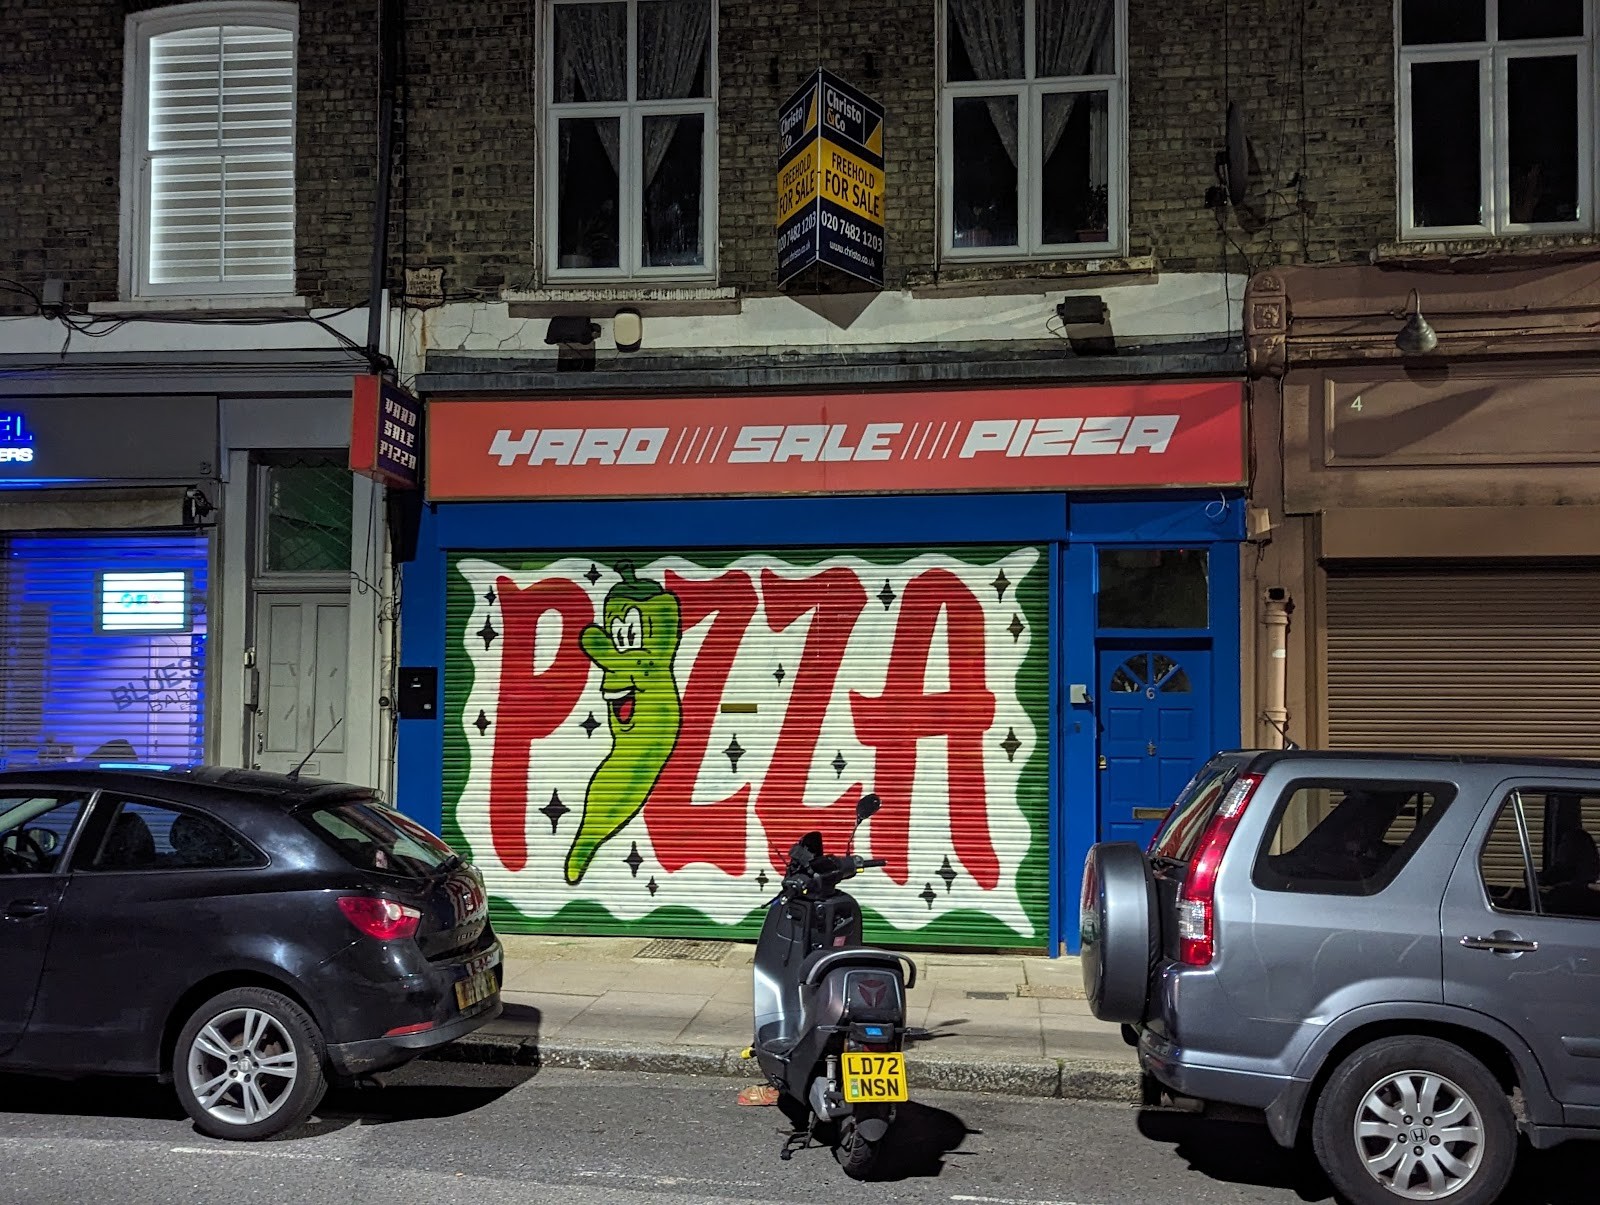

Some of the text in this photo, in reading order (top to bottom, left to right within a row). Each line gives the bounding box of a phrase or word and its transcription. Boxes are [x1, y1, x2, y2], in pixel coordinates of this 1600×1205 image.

[780, 106, 803, 136] Christo
[826, 88, 862, 124] Christo
[826, 108, 846, 132] &Co
[782, 153, 812, 188] FREEHOLD
[832, 152, 875, 189] FREEHOLD
[779, 168, 815, 219] FOR SALE
[825, 169, 880, 218] FOR SALE
[801, 210, 817, 235] 1203
[821, 210, 883, 253] 020 7482 1203
[1350, 394, 1363, 412] 4
[383, 420, 415, 448] SALE
[727, 422, 904, 466] SALE
[959, 414, 1180, 459] PIZZA
[1145, 686, 1156, 700] 6
[848, 1057, 900, 1076] LD72
[861, 1078, 900, 1097] NSN
